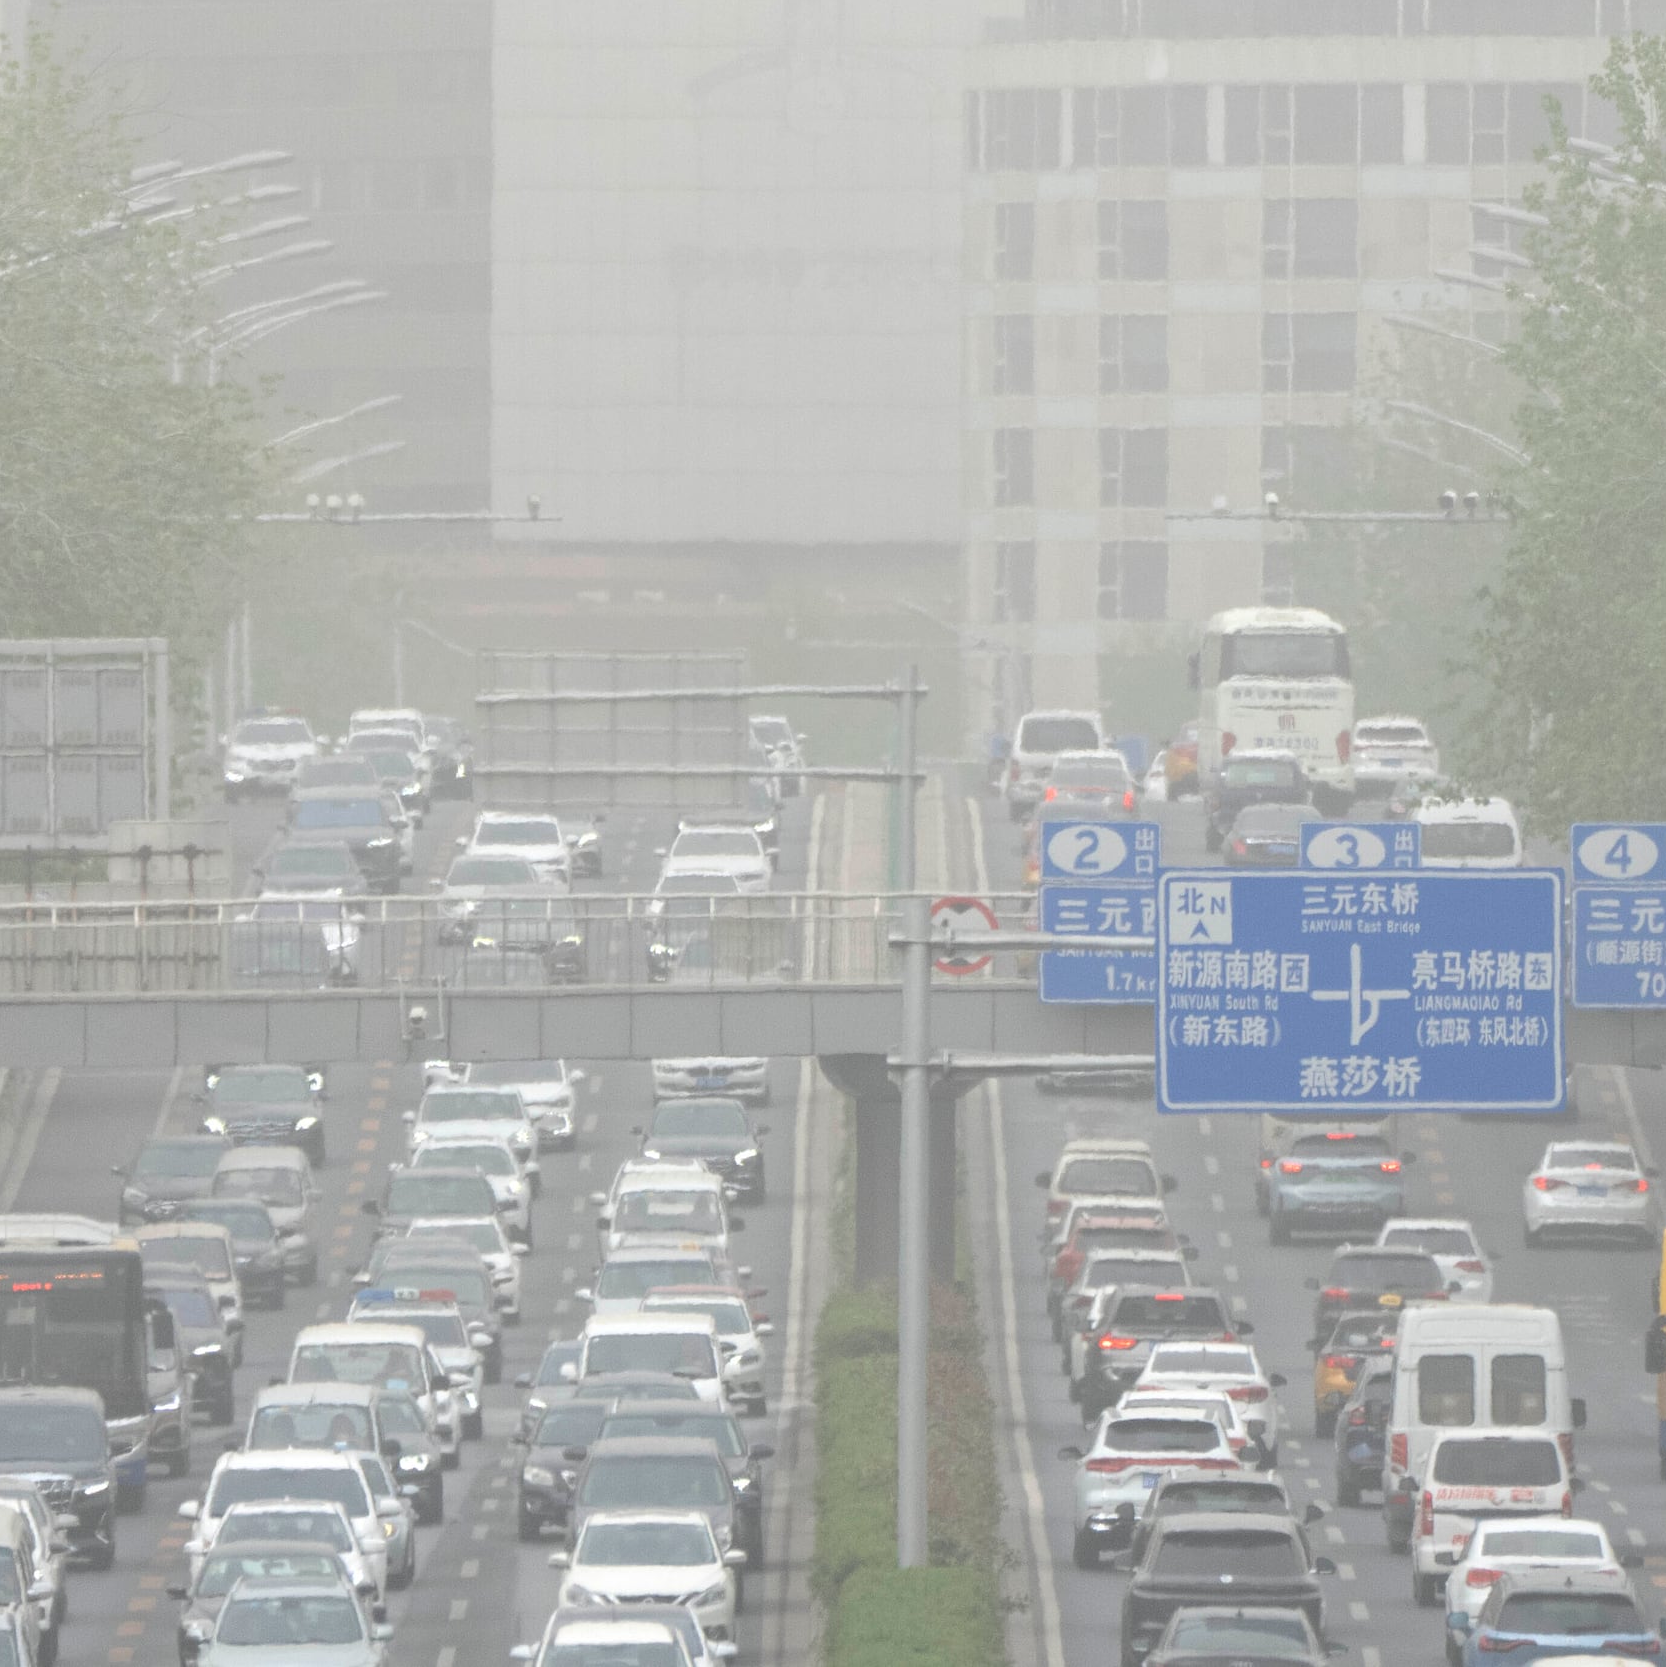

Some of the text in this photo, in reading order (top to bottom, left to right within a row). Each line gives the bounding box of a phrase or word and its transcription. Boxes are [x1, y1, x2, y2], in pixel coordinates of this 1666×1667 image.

[1074, 830, 1099, 870] 2
[1134, 828, 1155, 874] 出口
[1335, 833, 1361, 868] 3
[1394, 829, 1414, 868] 出口
[1605, 834, 1632, 874] 4
[1176, 887, 1227, 915] 北 N
[1301, 882, 1420, 916] 三元东桥
[1301, 919, 1421, 935] SANYUAN East Bridge
[1168, 949, 1306, 990] 新源南路 西
[1412, 949, 1550, 990] 亮马桥路 东
[1170, 994, 1279, 1011] XINYUAN South Rd
[1506, 994, 1523, 1011] Rd
[1169, 1014, 1282, 1047] (新东路)
[1417, 1015, 1549, 1047] (东四环 东风北桥)
[1299, 1056, 1422, 1098] 燕莎桥
